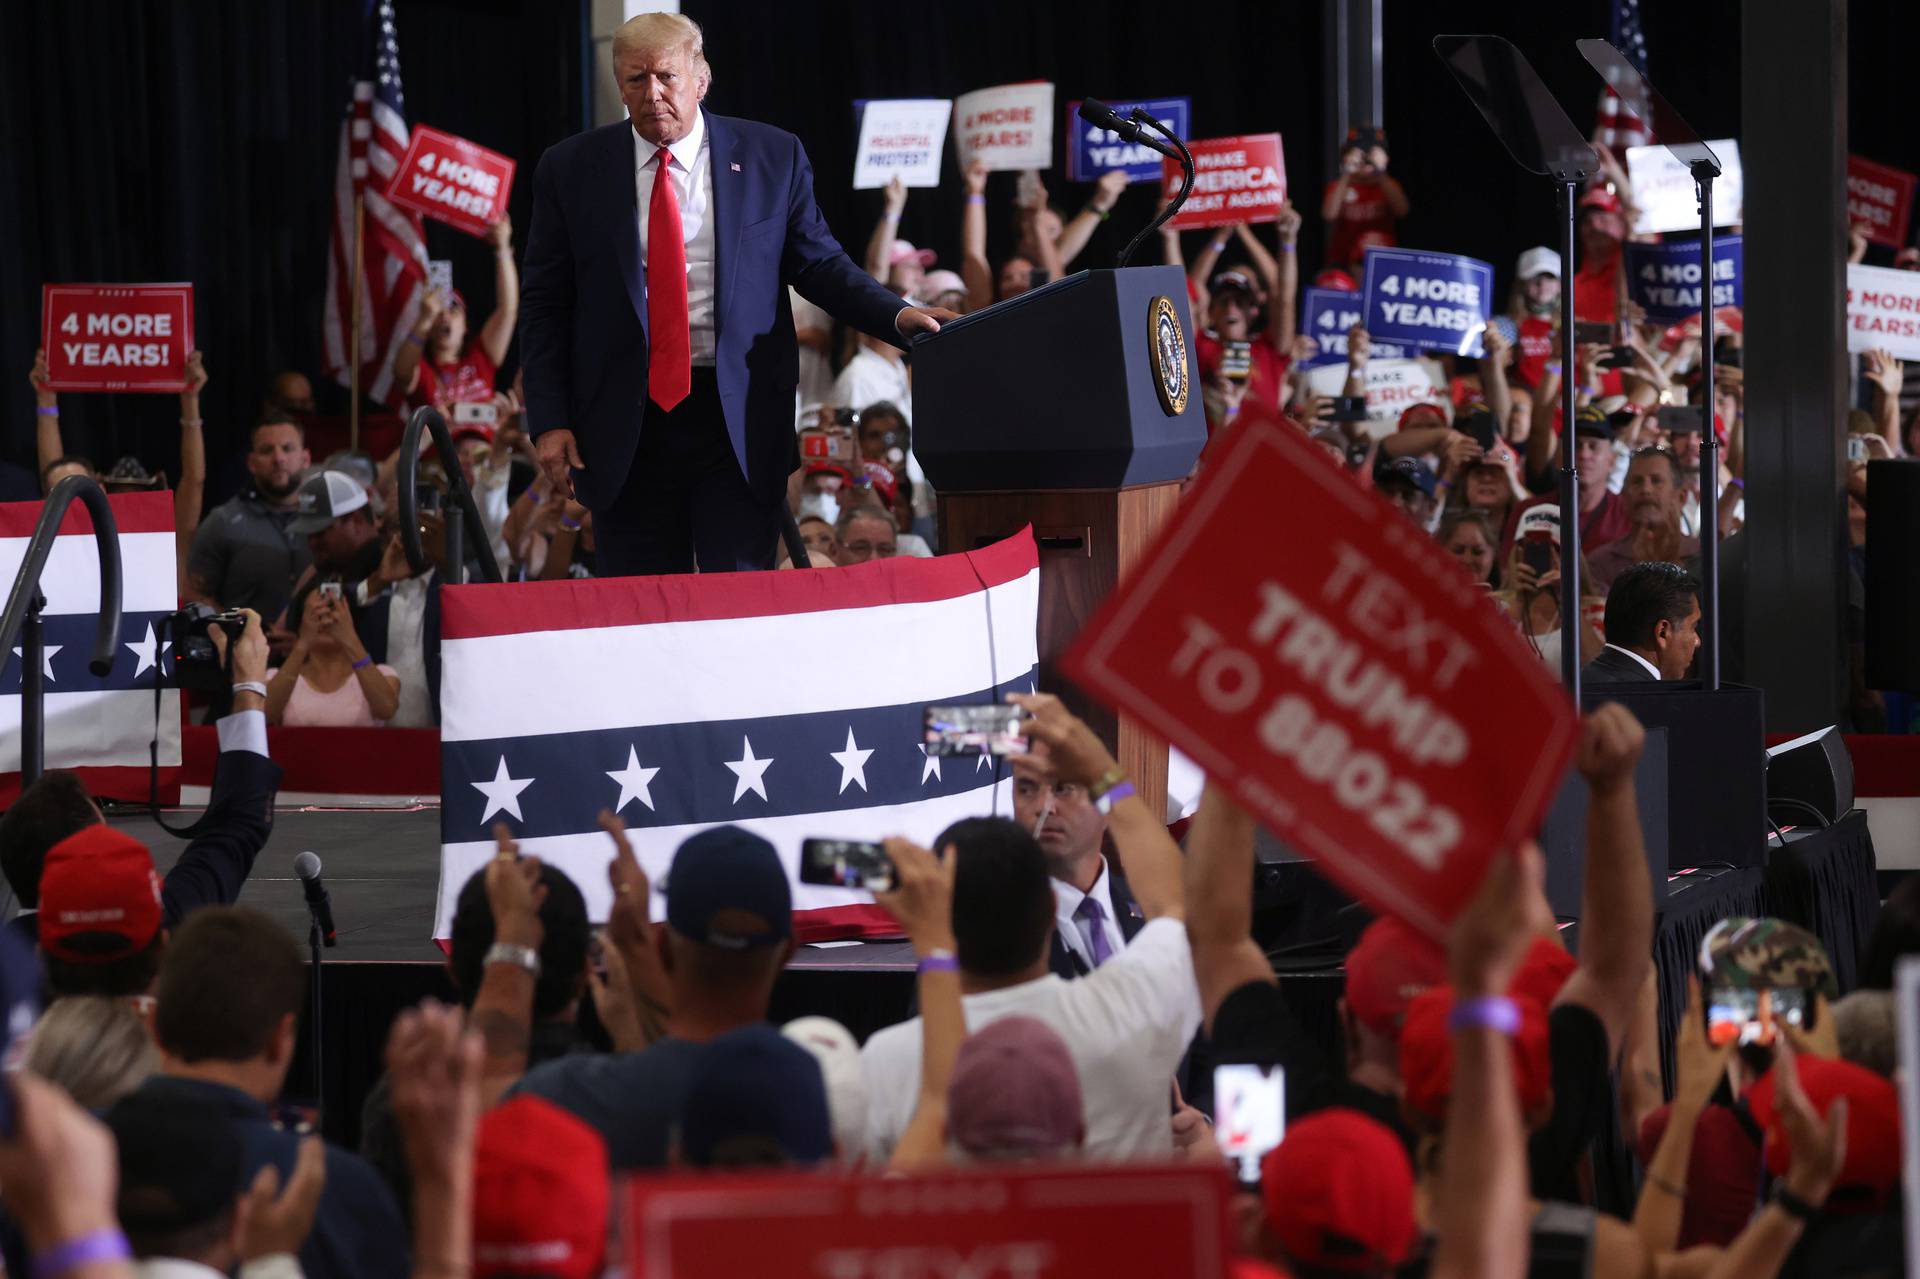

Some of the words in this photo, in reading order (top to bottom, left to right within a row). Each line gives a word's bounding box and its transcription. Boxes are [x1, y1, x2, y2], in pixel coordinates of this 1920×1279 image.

[977, 106, 1036, 127] MORE
[866, 150, 930, 169] PROTEST
[1196, 151, 1247, 168] MAKE
[417, 151, 436, 173] 4
[436, 157, 500, 199] MORE
[412, 172, 494, 219] YEARS!
[1227, 188, 1283, 209] AGAIN
[1640, 263, 1656, 282] 4
[1661, 259, 1735, 284] MOE
[1379, 274, 1400, 297] 4
[1404, 276, 1480, 307] MORE
[60, 312, 80, 336] 4
[87, 313, 172, 337] MORE
[1317, 309, 1336, 330] 4
[1380, 301, 1478, 333] YEARS!
[63, 342, 170, 367] YEARS!
[1322, 541, 1482, 691] TEXT
[1247, 580, 1471, 768] TRUMP
[1167, 614, 1264, 714] TO
[1257, 691, 1466, 872] 88022
